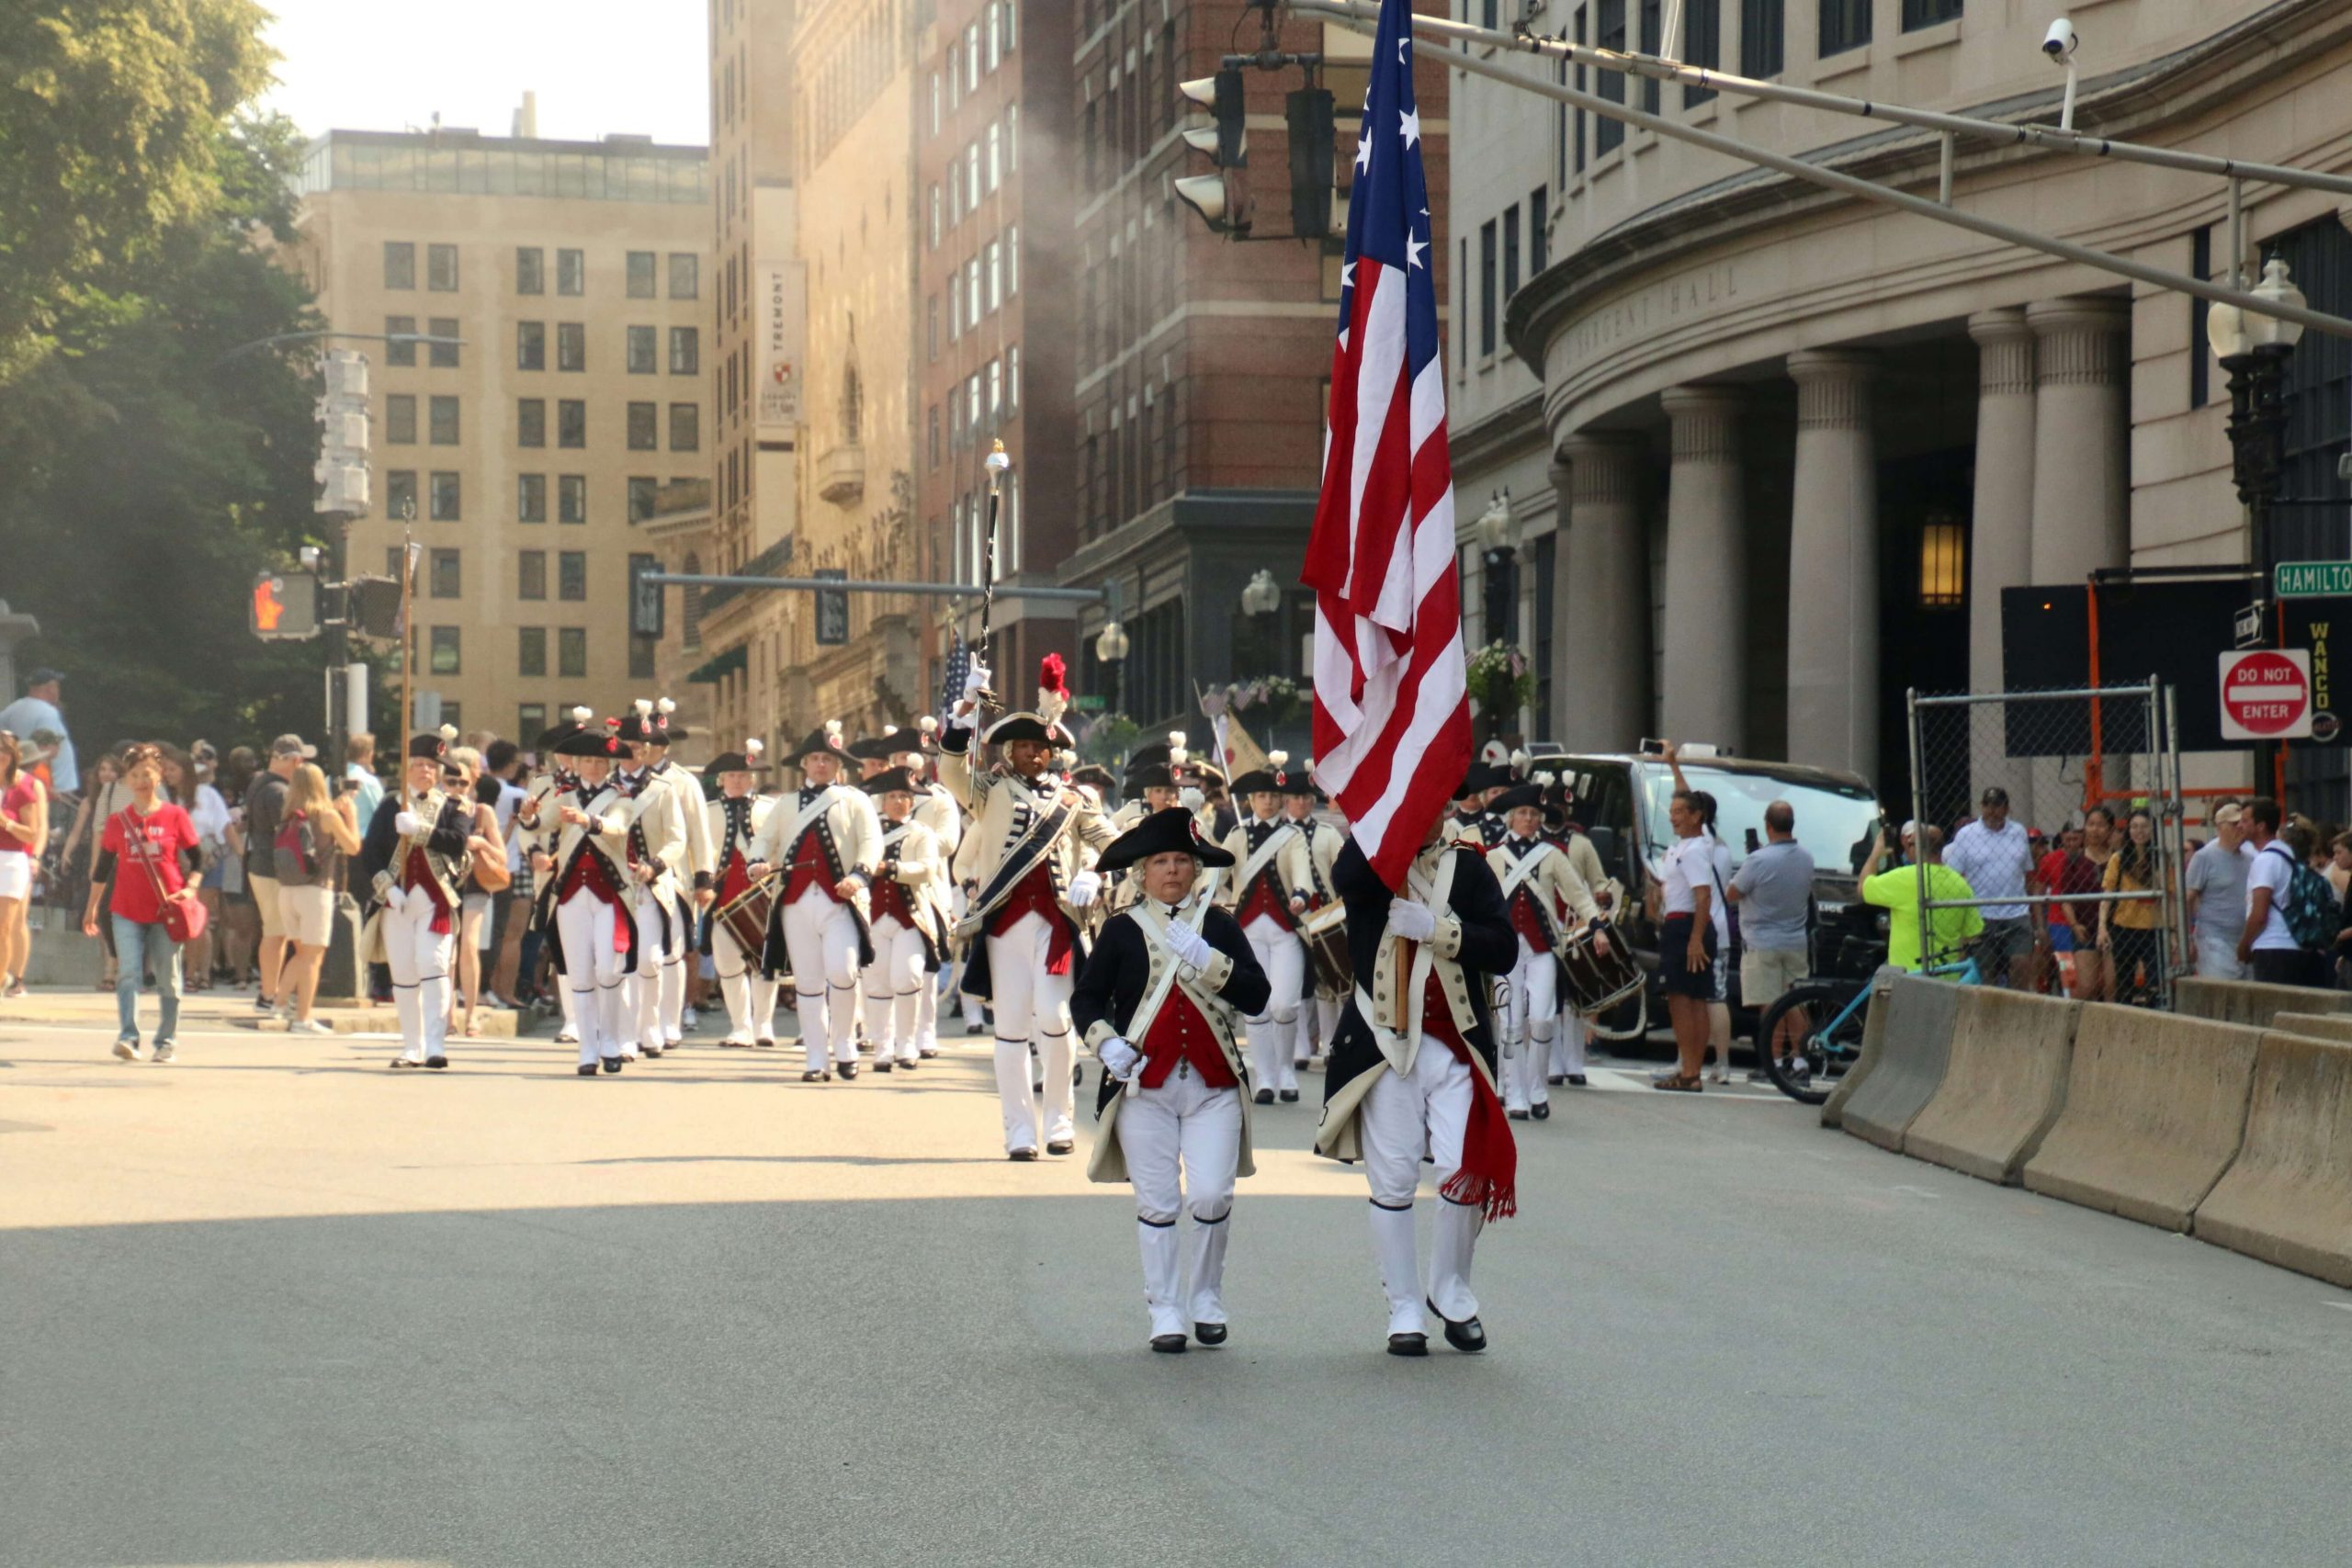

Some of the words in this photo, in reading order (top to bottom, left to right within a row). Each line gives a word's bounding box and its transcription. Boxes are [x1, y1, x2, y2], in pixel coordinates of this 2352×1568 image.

[1671, 266, 1737, 315] HALL
[772, 272, 784, 352] TREMONT
[2280, 567, 2352, 592] HAMILTO
[2237, 669, 2257, 682] DO
[2264, 667, 2291, 682] NOT
[2309, 623, 2329, 709] WANCO
[2243, 704, 2289, 719] ENTER
